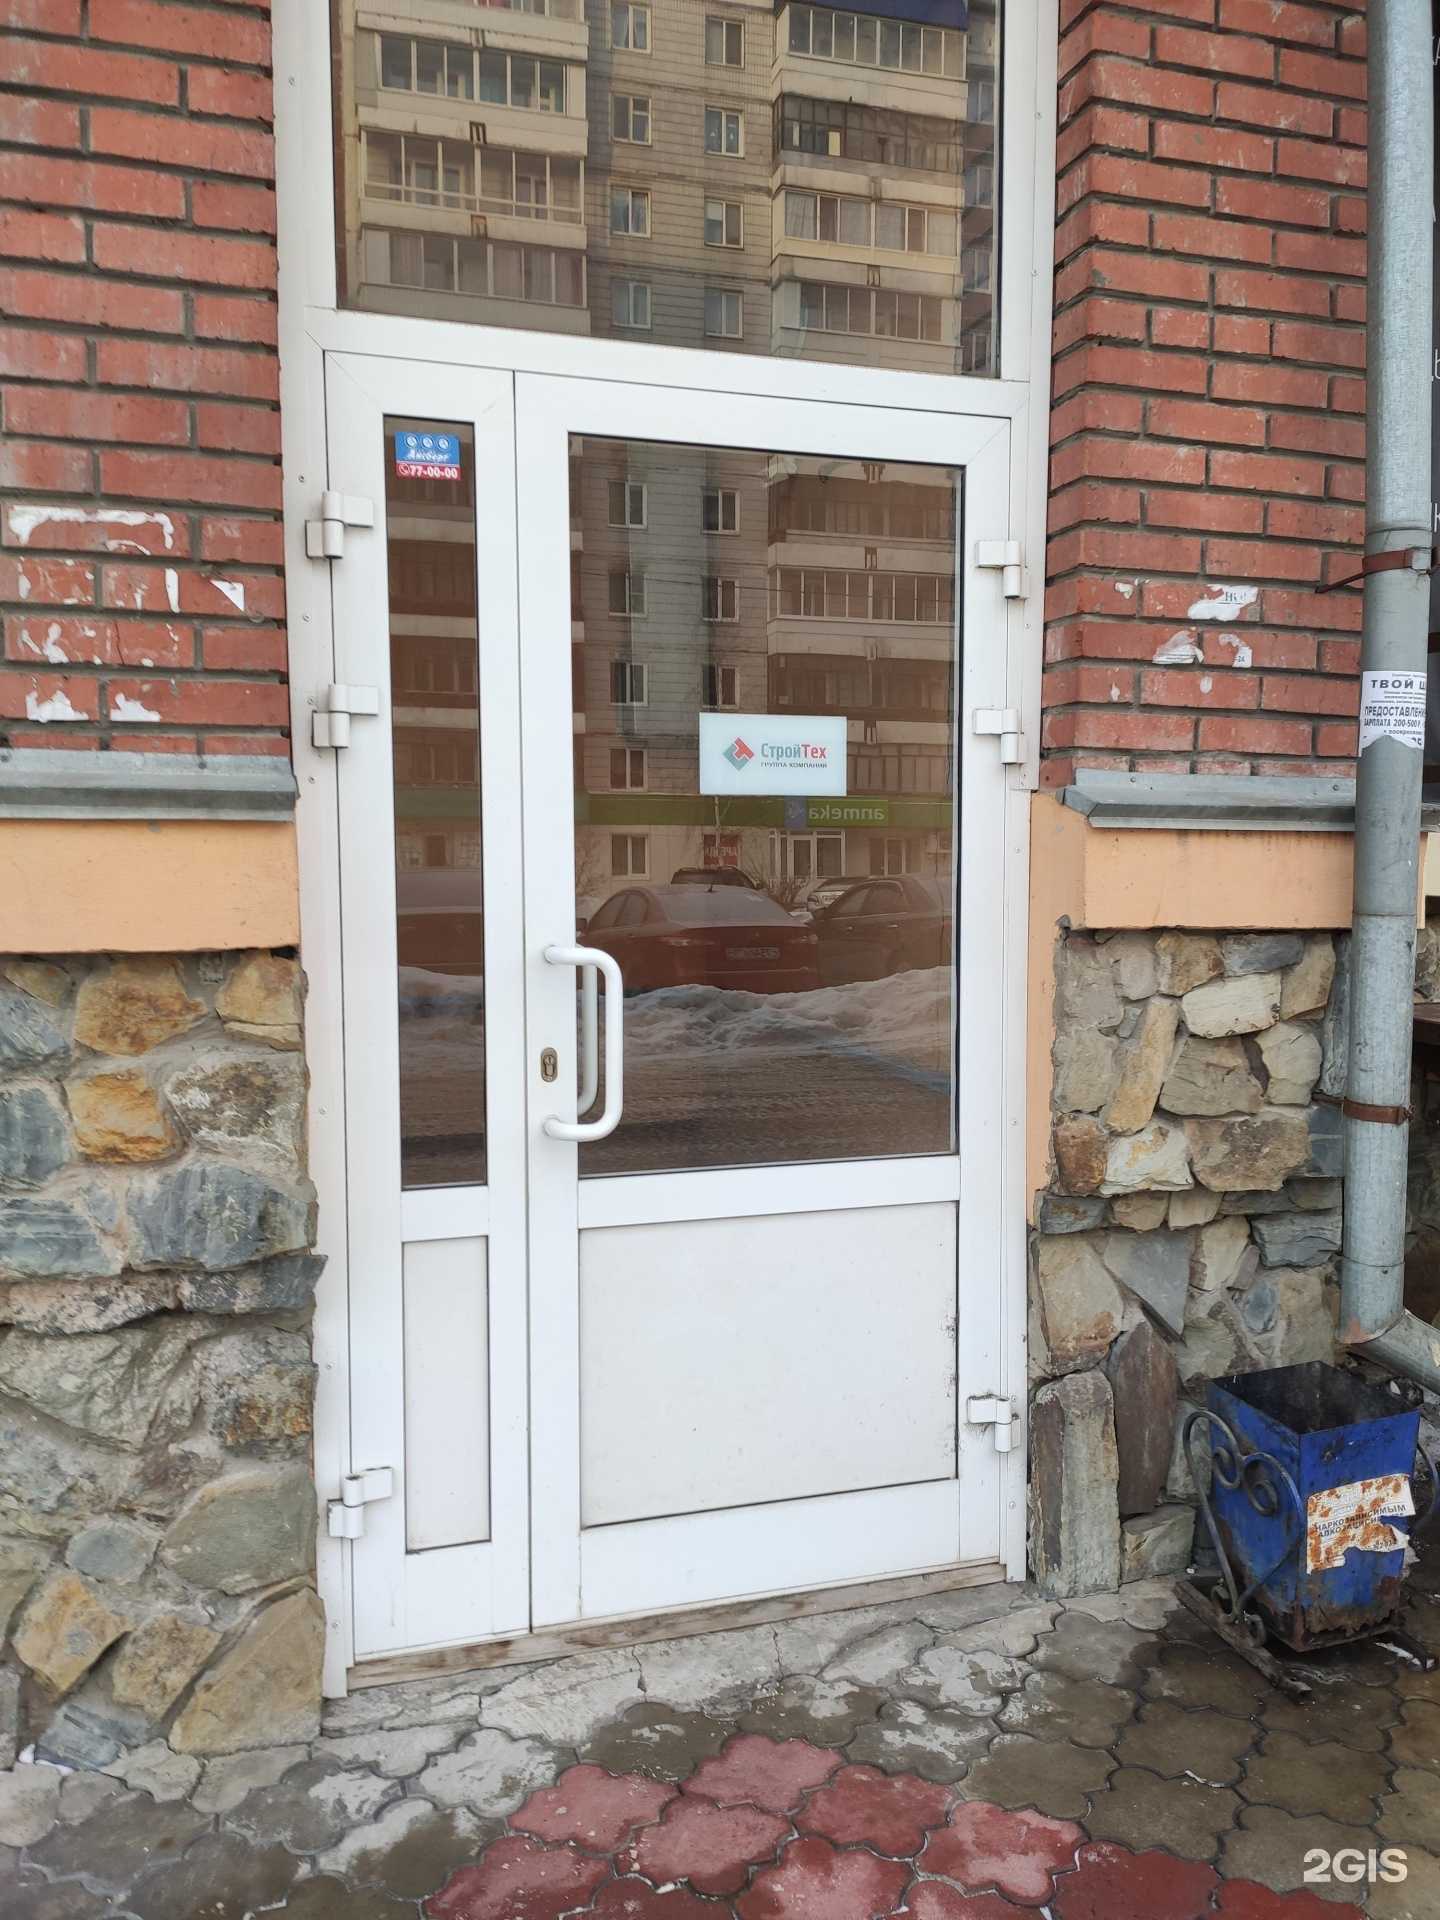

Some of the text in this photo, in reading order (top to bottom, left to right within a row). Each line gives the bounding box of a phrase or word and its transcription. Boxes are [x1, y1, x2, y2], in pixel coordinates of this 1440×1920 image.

[409, 465, 458, 479] 77-00-00
[1371, 679, 1414, 689] ТВОЙ
[760, 743, 827, 761] СтройТех
